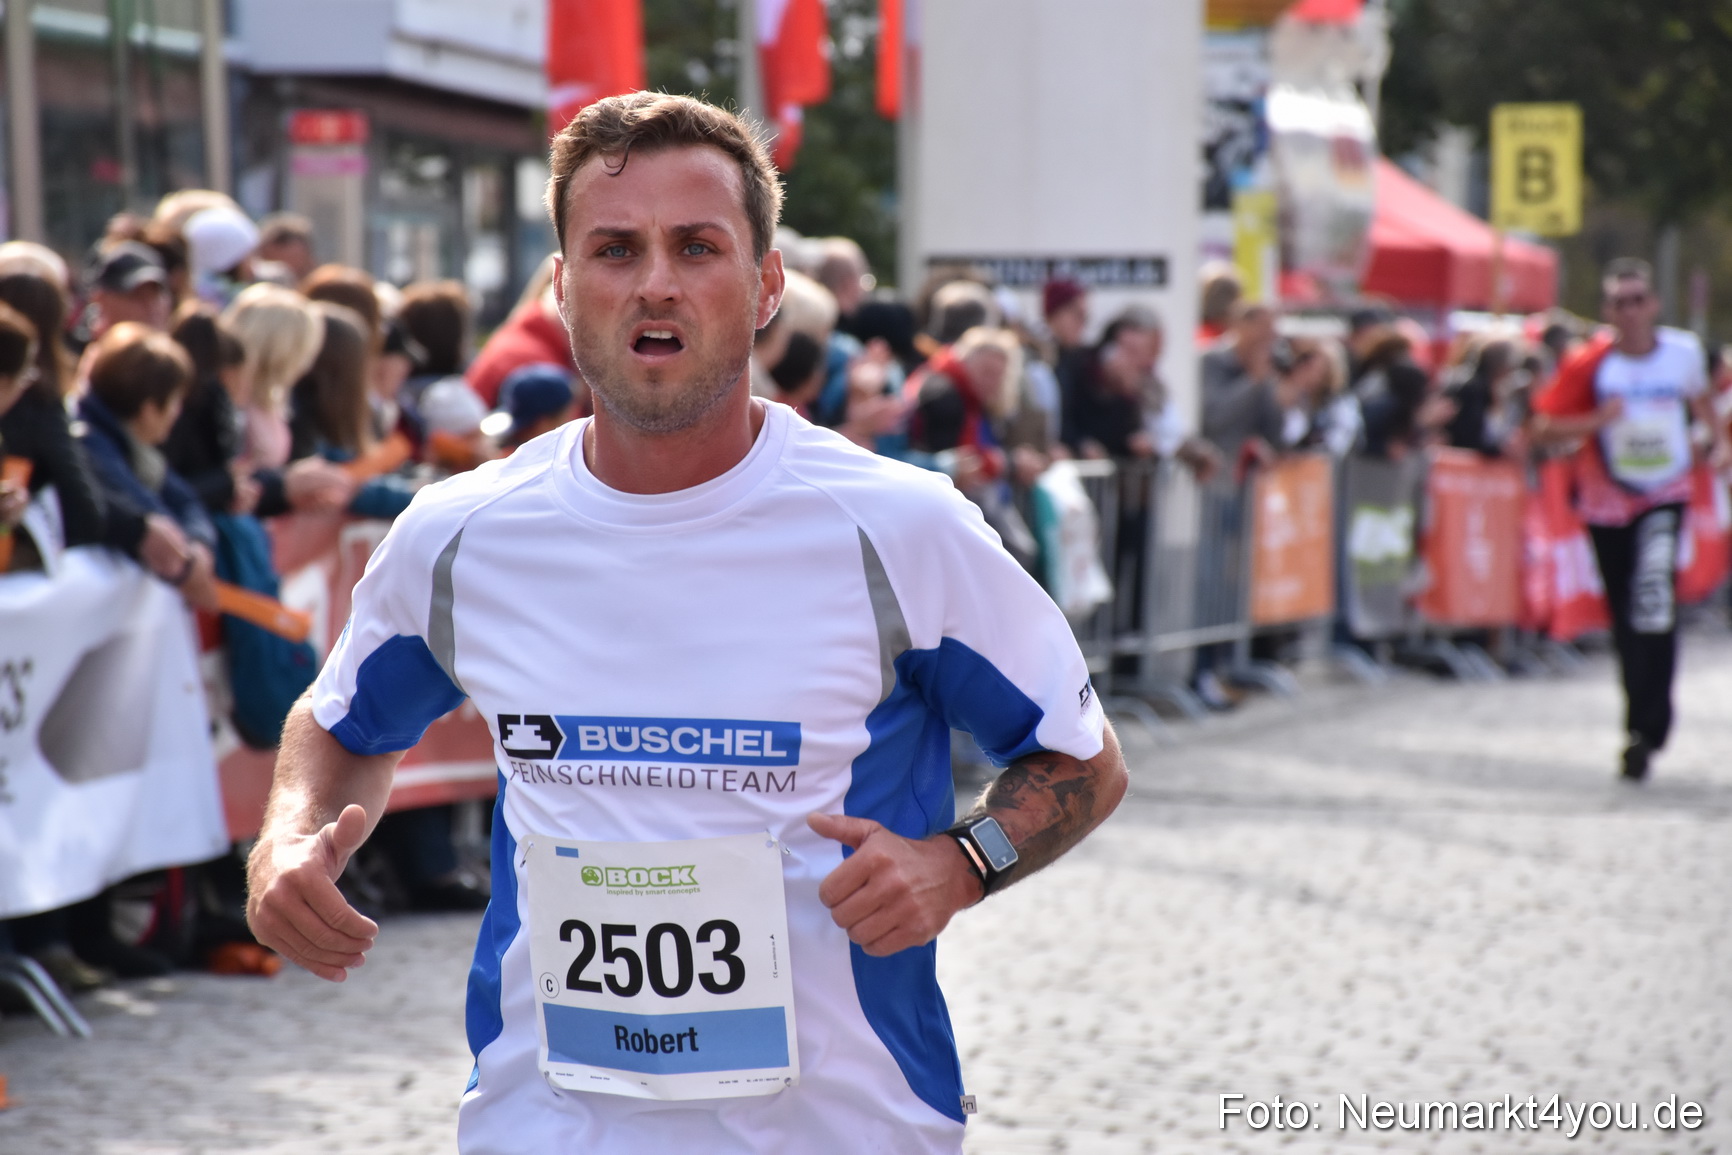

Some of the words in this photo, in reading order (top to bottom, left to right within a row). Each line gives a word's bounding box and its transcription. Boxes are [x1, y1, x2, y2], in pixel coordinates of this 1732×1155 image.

[1516, 146, 1557, 204] B
[578, 725, 788, 757] BÜSCHEL
[509, 760, 797, 793] FEINSCHNEIDTEAM
[605, 865, 699, 887] BOCK
[606, 888, 634, 896] inspired
[634, 889, 644, 897] by
[667, 887, 701, 896] concepts
[559, 919, 745, 998] 2503
[614, 1024, 699, 1054] Robert
